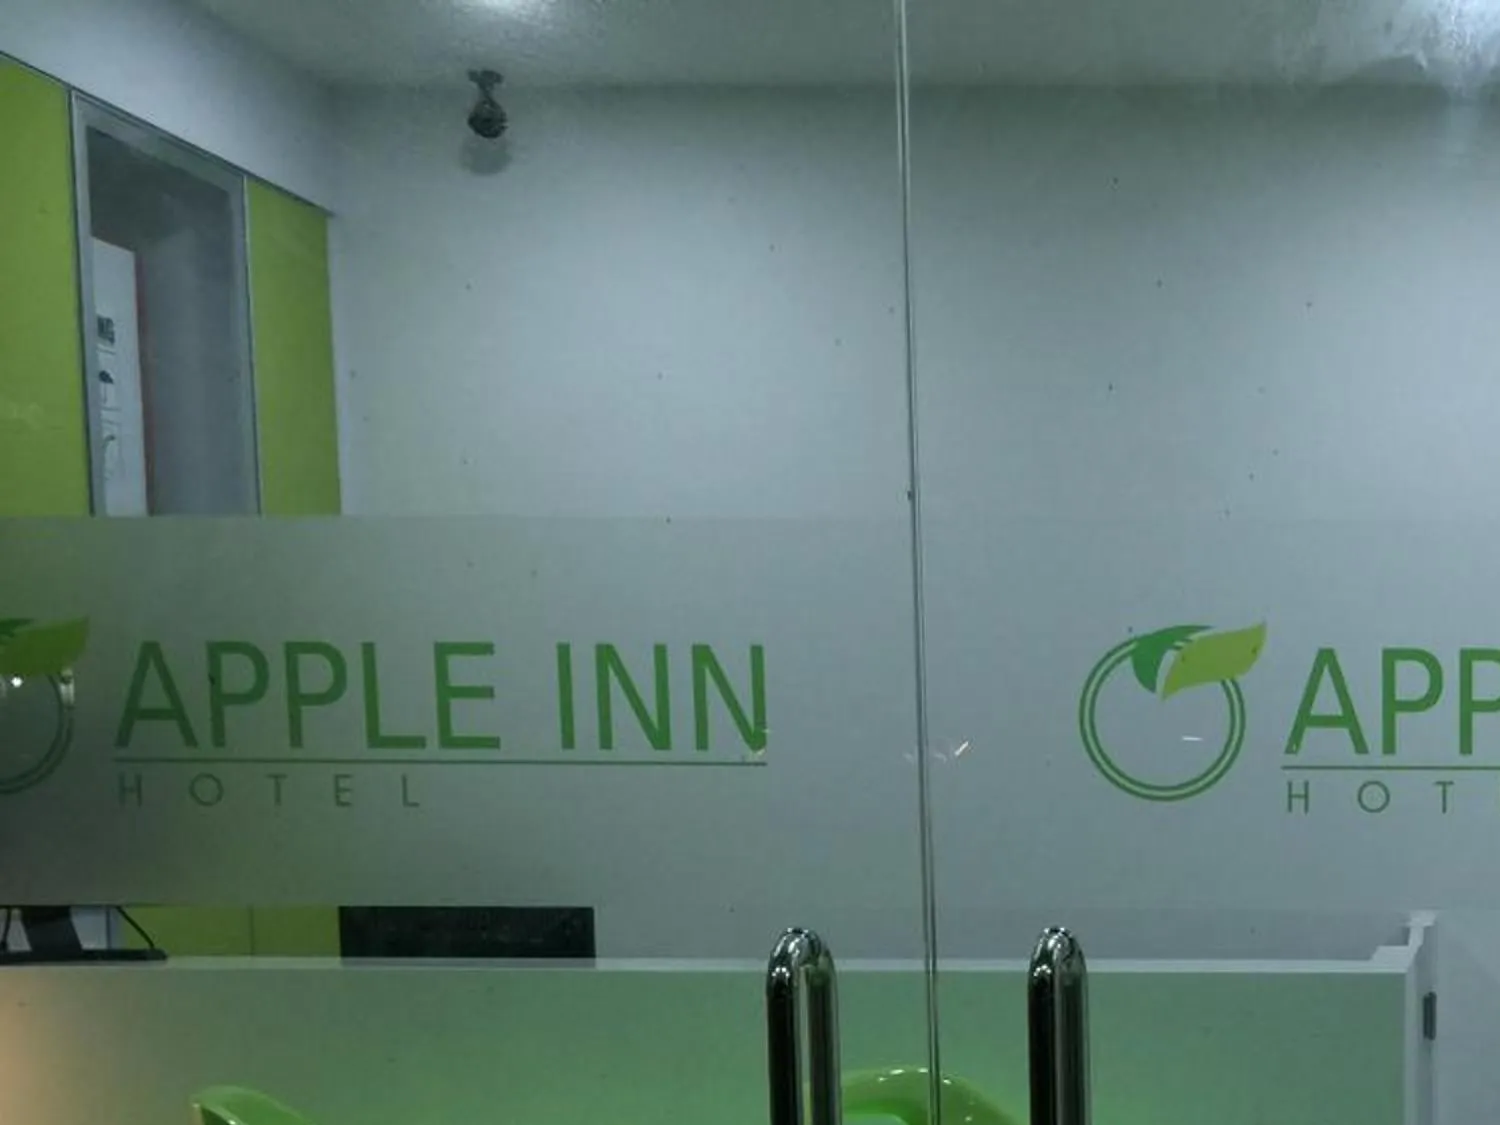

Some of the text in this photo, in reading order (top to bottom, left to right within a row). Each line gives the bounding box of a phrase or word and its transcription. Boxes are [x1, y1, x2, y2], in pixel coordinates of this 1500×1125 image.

[114, 640, 768, 752] APPLE INN
[118, 772, 421, 808] HOTEL
